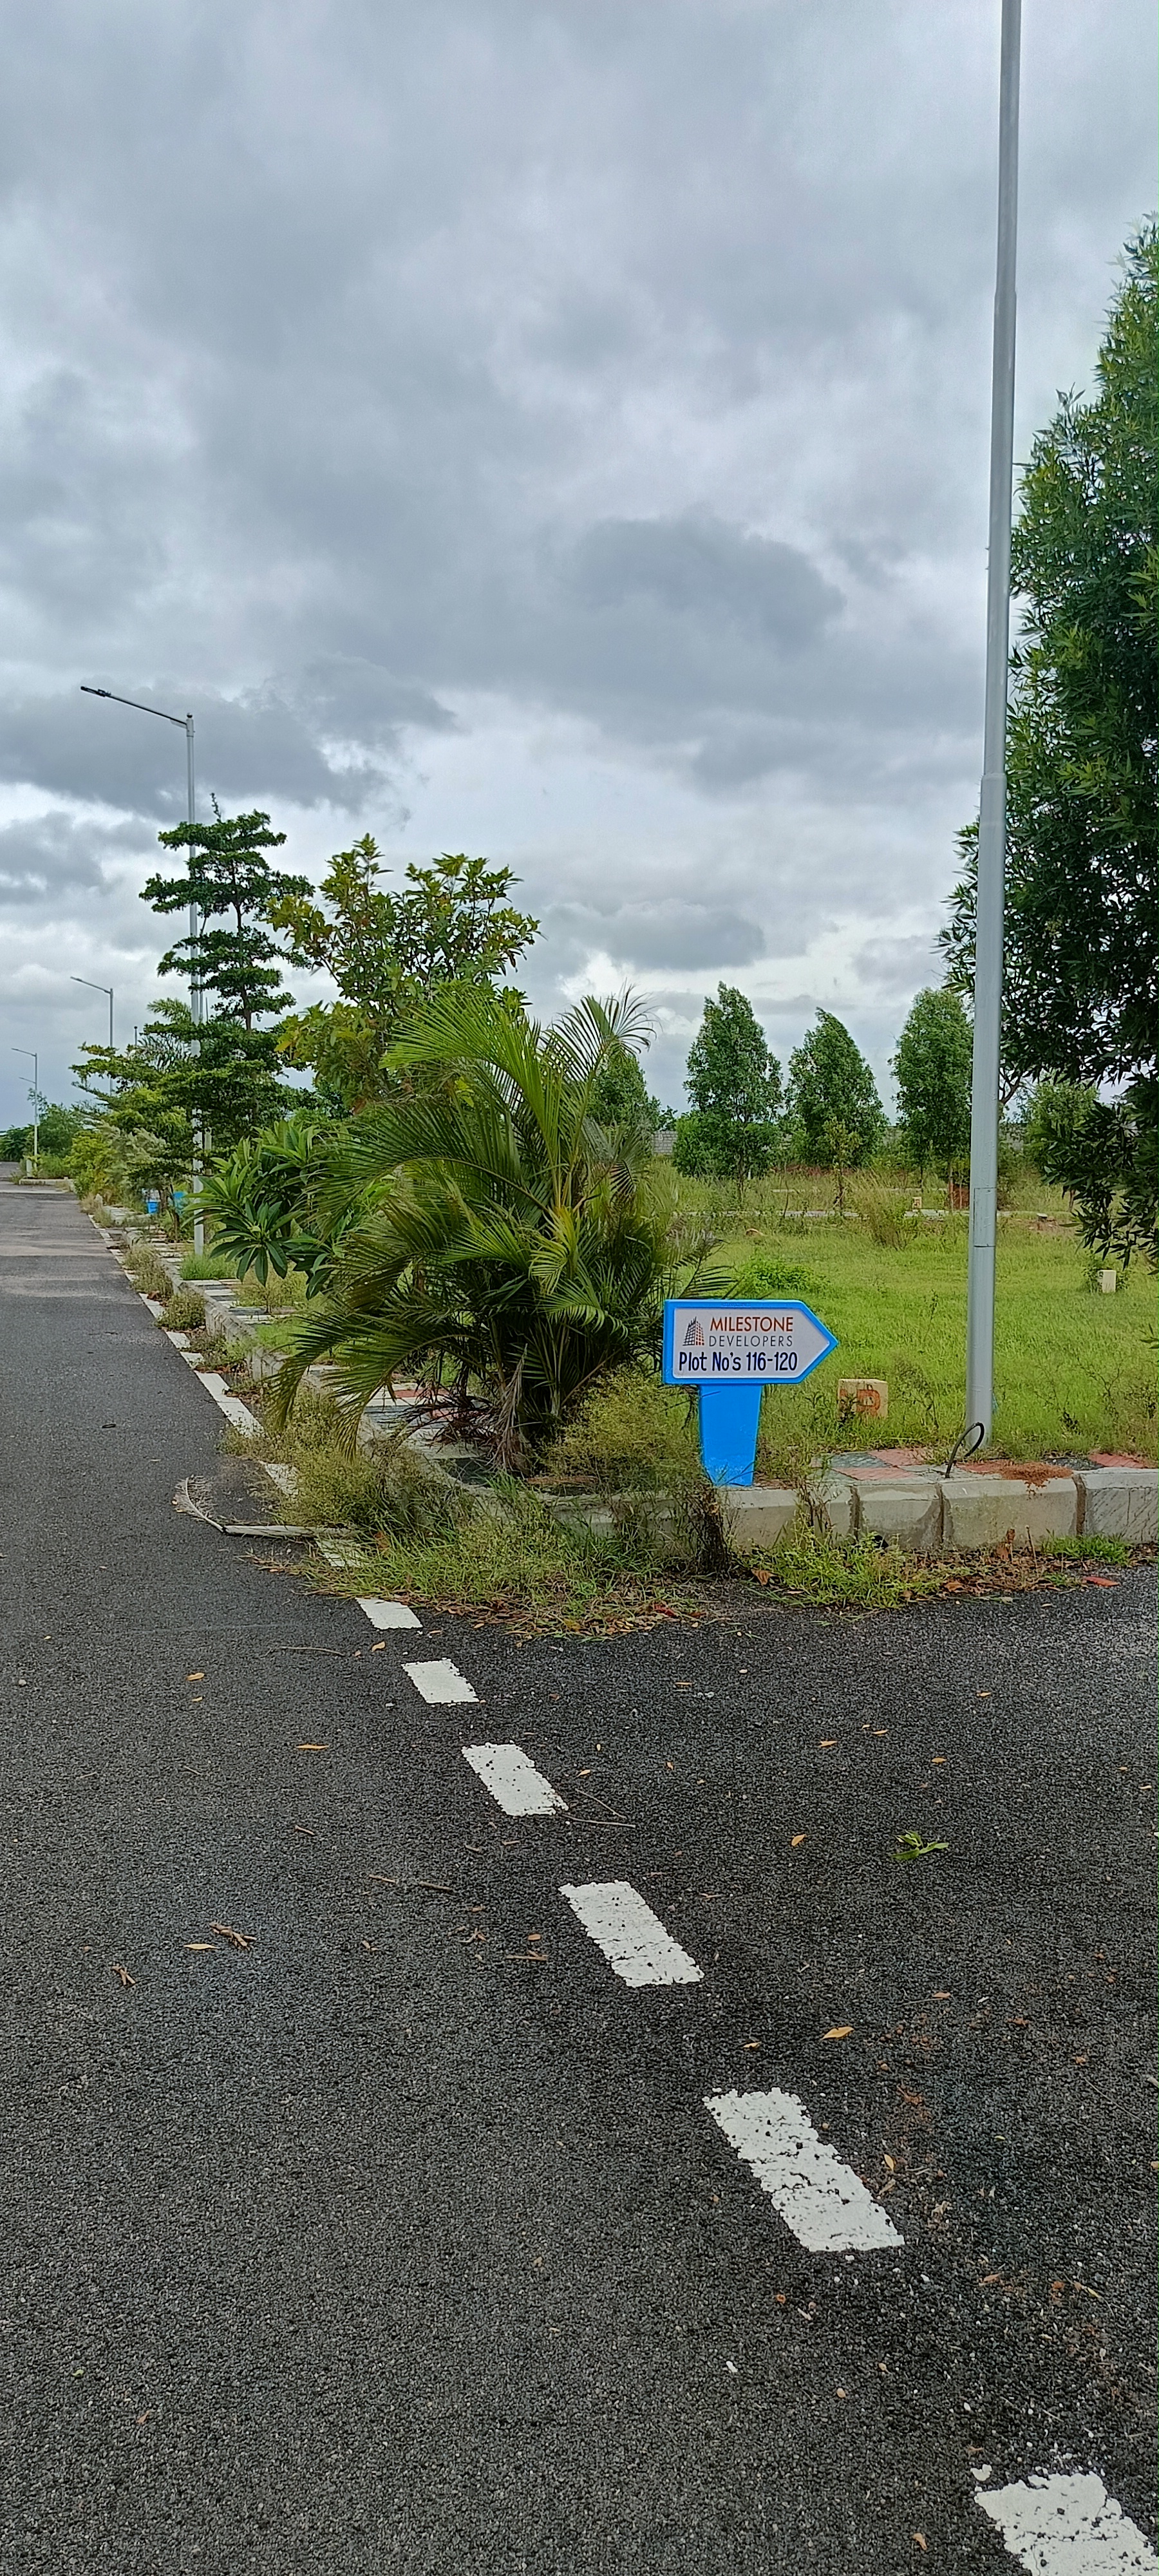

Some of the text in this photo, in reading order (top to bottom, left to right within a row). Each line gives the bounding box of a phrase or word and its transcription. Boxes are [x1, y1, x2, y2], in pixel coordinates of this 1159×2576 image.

[710, 1316, 793, 1332] MILESTONE
[709, 1335, 793, 1347] DEVELOPERS
[679, 1351, 798, 1371] Plot No's 116-120
